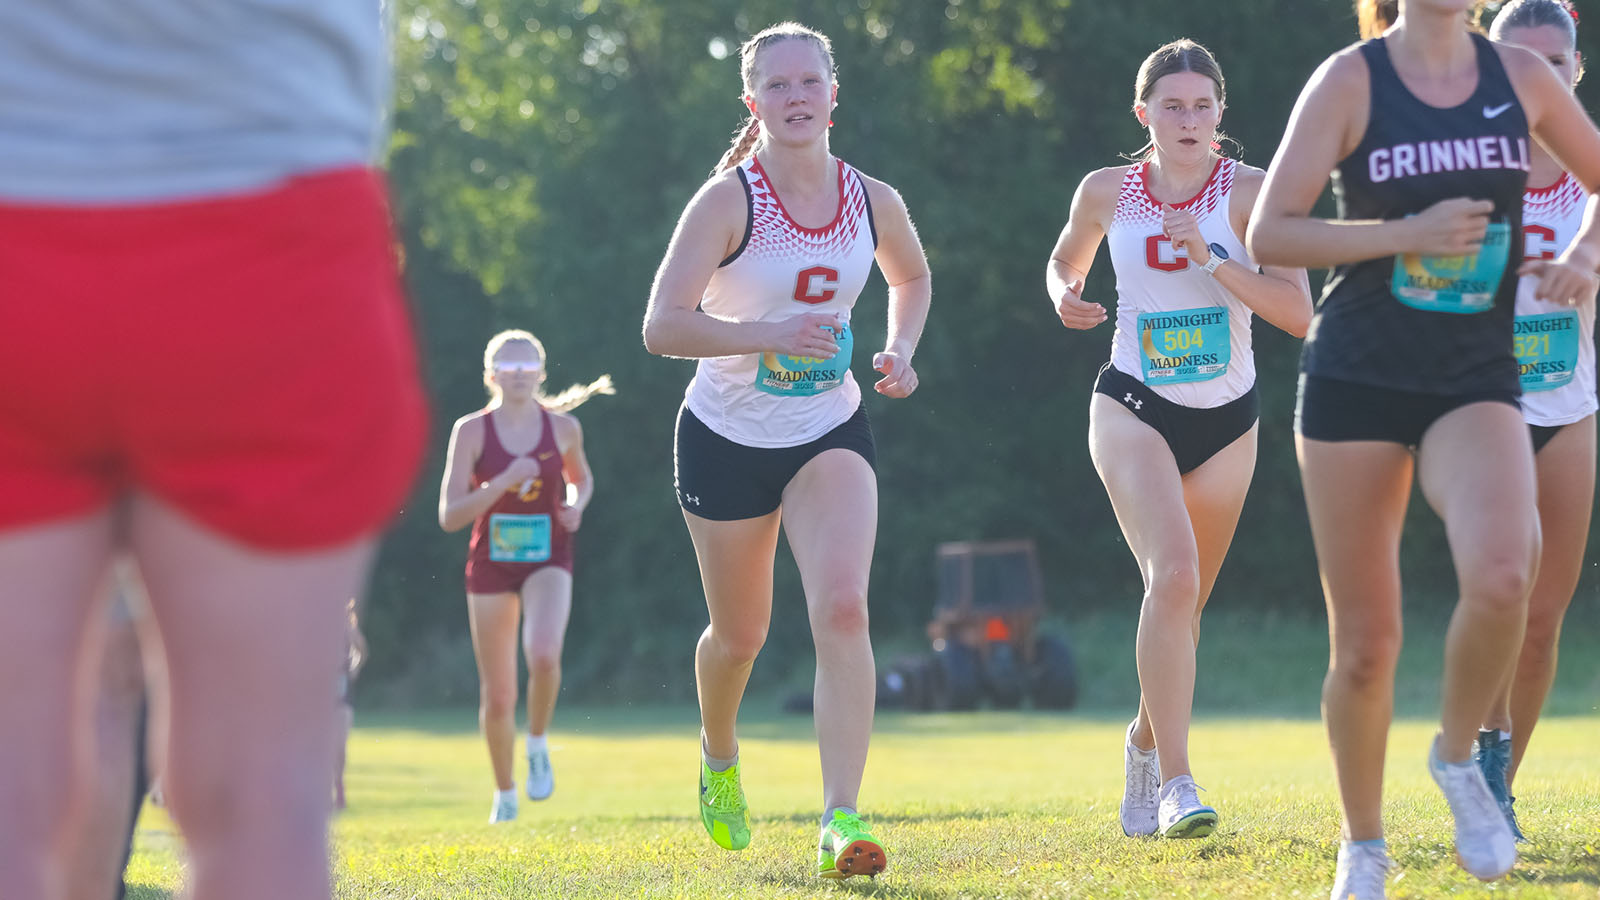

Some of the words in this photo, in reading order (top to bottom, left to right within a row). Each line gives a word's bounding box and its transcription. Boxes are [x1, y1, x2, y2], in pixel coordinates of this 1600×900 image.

[1368, 136, 1531, 183] GRINNELL
[1145, 232, 1189, 273] C
[793, 265, 839, 305] C
[1143, 312, 1224, 331] MIDNIGHT
[1512, 317, 1574, 335] DNIGHT
[1164, 327, 1204, 351] 504
[1512, 333, 1550, 358] 521
[1149, 353, 1218, 370] MADNESS
[1519, 360, 1566, 376] DNESS
[768, 369, 836, 382] MADNESS
